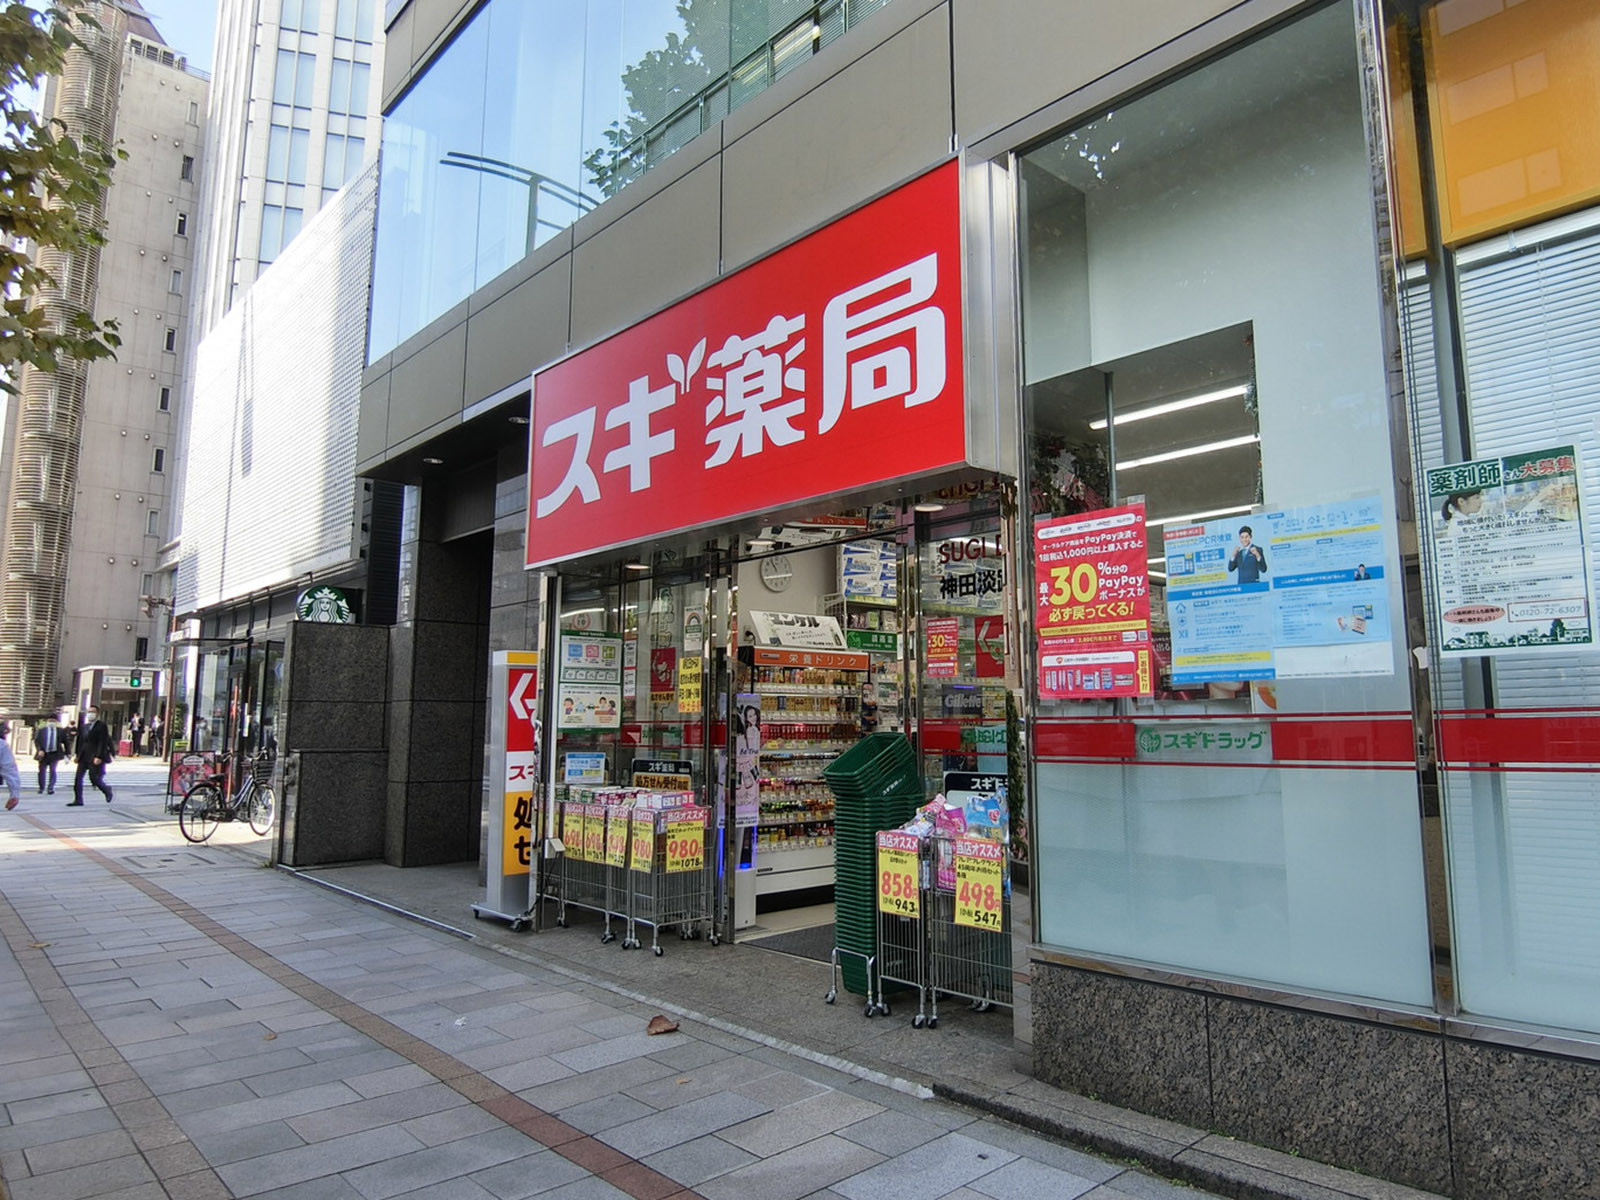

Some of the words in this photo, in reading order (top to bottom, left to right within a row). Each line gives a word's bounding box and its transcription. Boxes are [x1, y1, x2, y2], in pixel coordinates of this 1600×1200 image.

[536, 252, 946, 519] スギ薬局
[1430, 462, 1501, 492] 薬剤師
[1503, 456, 1575, 480] さん大募集
[939, 536, 986, 564] SUGI
[1039, 540, 1144, 562] 1回税込1,000円以上購入すると
[1097, 561, 1128, 576] %分の
[1049, 563, 1098, 605] 30
[1098, 575, 1144, 589] PayPay
[1039, 582, 1049, 606] 最大
[1099, 587, 1145, 601] ボーナスが
[1049, 601, 1135, 622] 必ず戻ってくる!
[1519, 605, 1582, 617] 0120-72-6307
[788, 653, 857, 666] 栄養ドリンク
[944, 693, 981, 708] Gillette
[1163, 731, 1268, 749] スギドラッグ
[880, 834, 918, 850] 当店オススメ
[956, 840, 1000, 858] 当店オススメ
